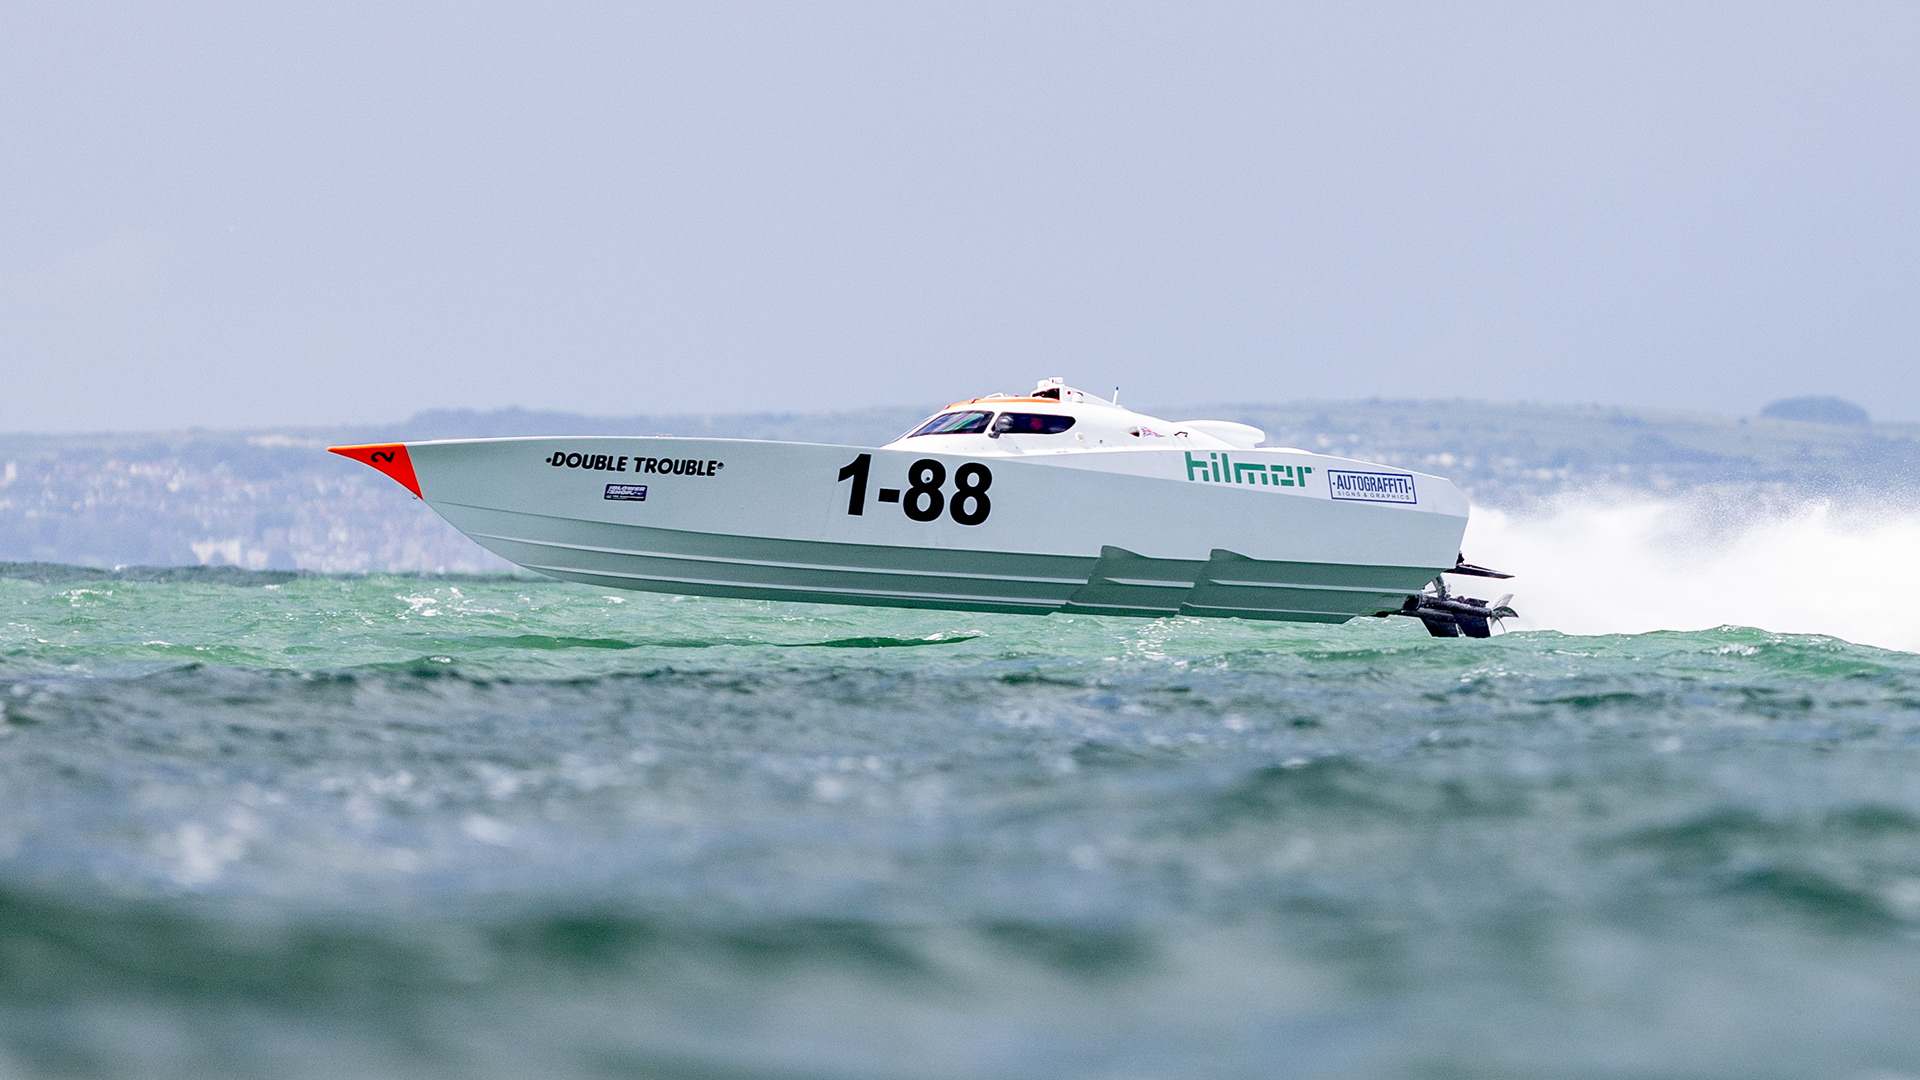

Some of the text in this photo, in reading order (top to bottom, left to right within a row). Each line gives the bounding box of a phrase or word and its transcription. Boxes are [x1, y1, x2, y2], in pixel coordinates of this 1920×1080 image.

[371, 451, 395, 463] 2
[551, 451, 717, 476] DOUBLE TROUBLE
[838, 453, 992, 526] 1-88
[1337, 474, 1409, 494] AUTOGRAFFITI
[1369, 492, 1410, 500] GRAPHICS
